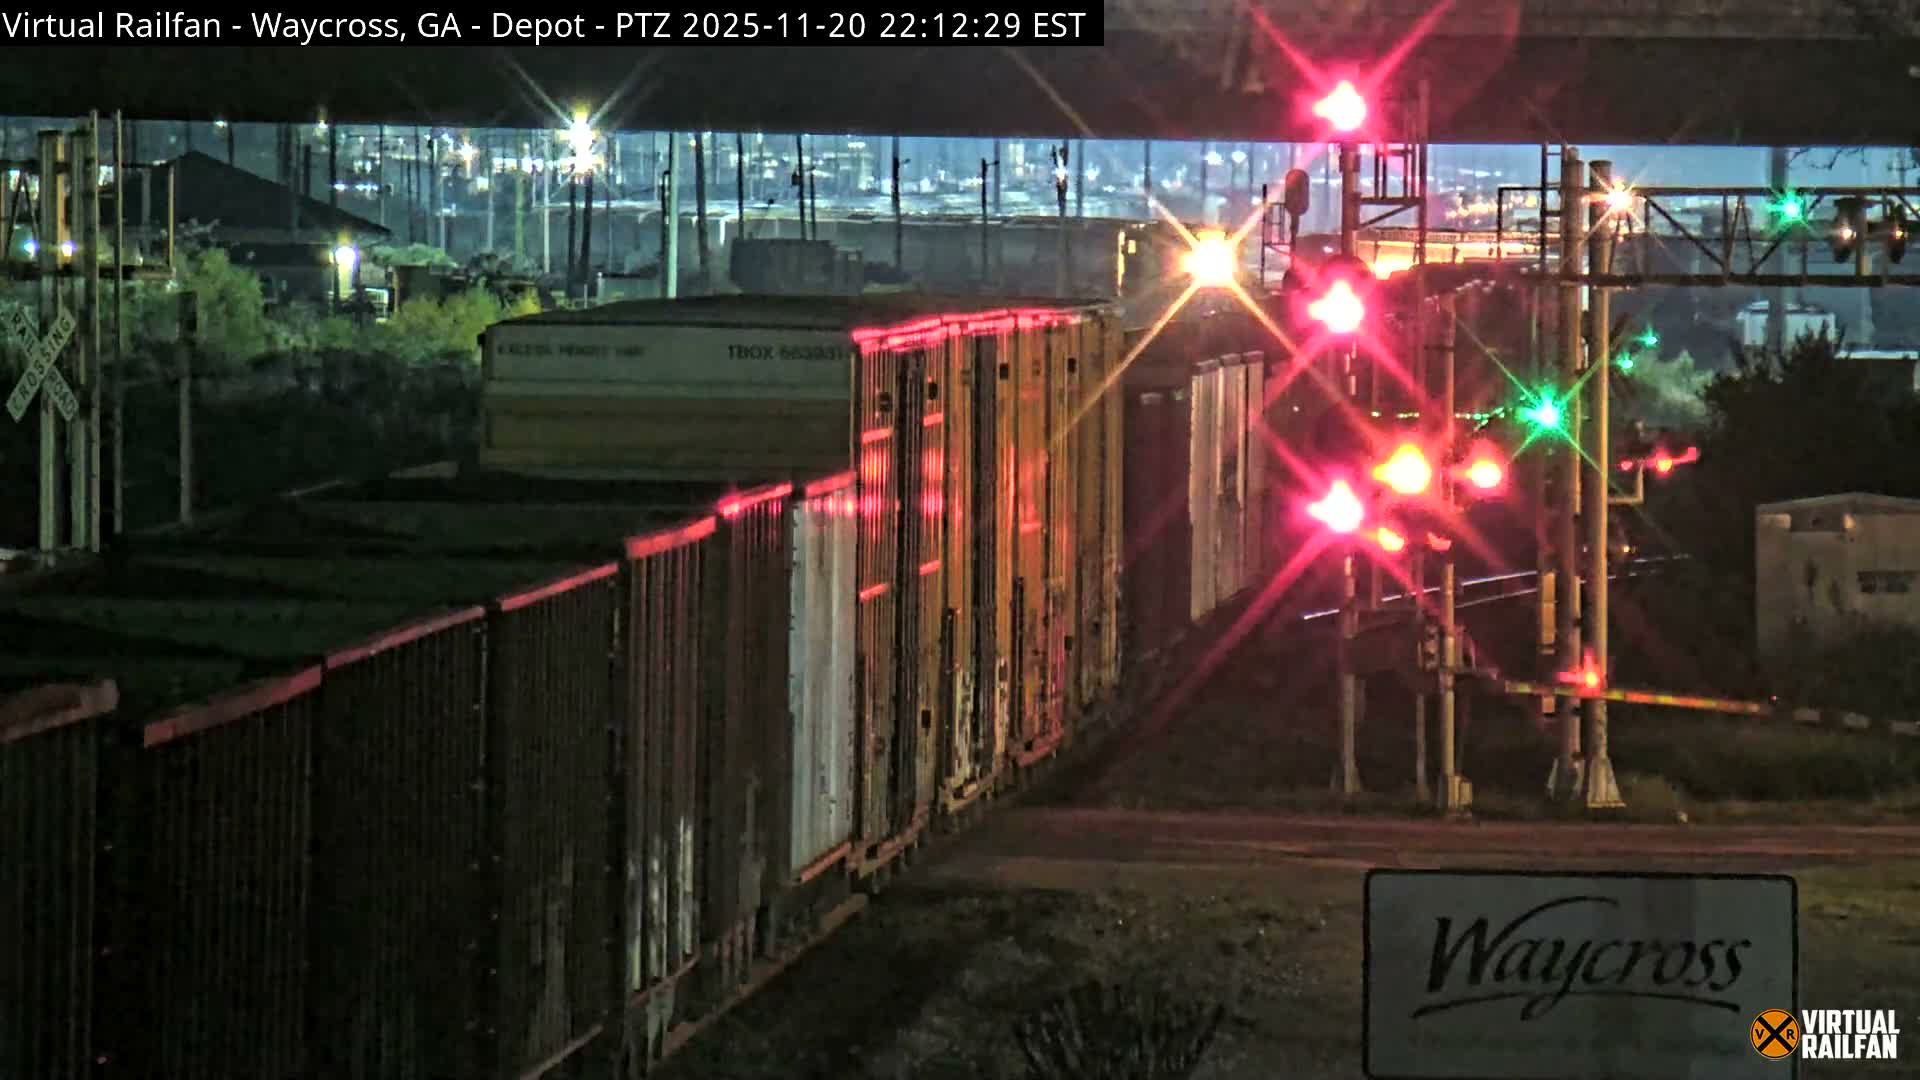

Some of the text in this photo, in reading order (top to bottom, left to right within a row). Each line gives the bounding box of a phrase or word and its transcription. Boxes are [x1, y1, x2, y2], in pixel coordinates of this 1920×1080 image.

[11, 315, 72, 413] CROSSING
[728, 344, 774, 361] TBOX
[1425, 896, 1753, 1021] Waycross
